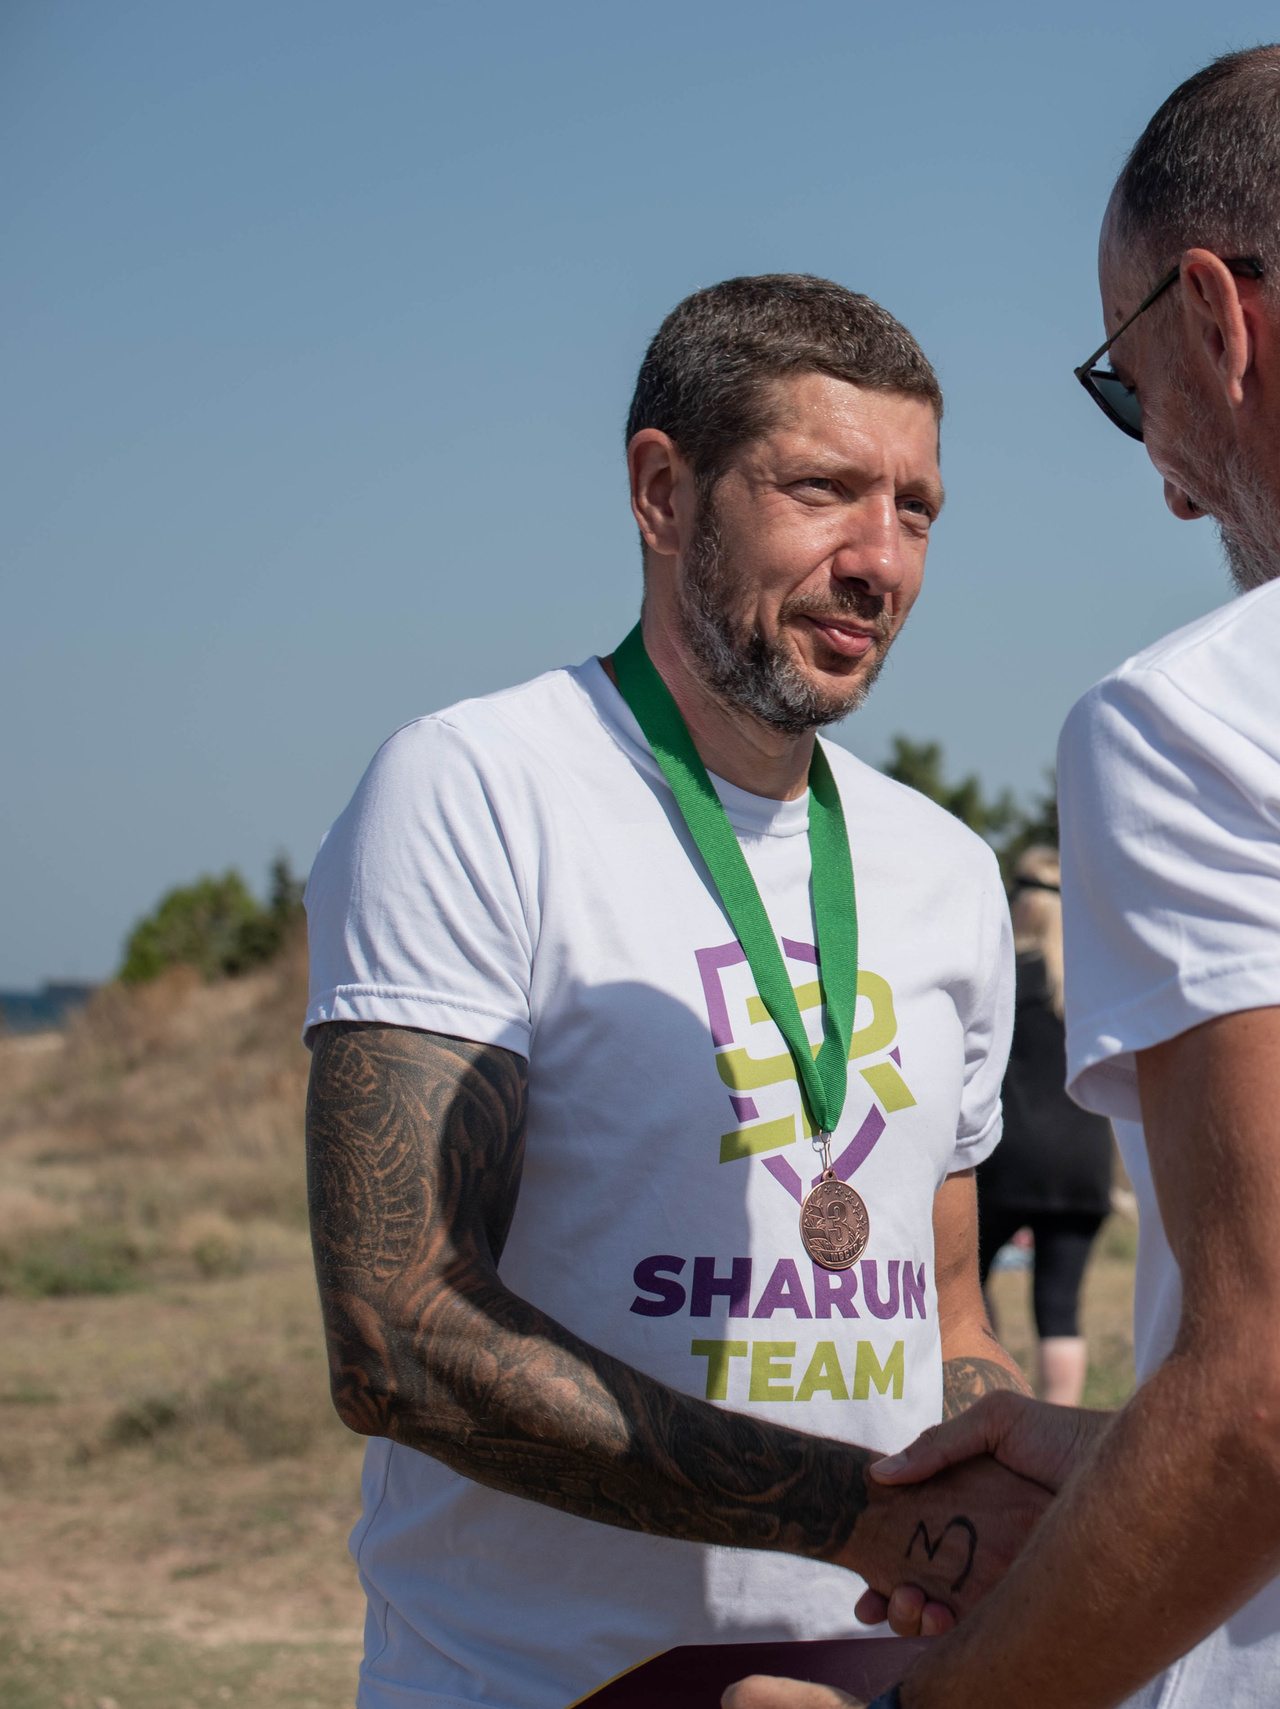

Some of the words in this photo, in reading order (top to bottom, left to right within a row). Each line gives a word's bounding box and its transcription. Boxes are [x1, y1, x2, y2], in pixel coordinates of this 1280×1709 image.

[827, 1200, 850, 1247] 3
[629, 1254, 927, 1320] SHARUN
[690, 1338, 905, 1402] TEAM
